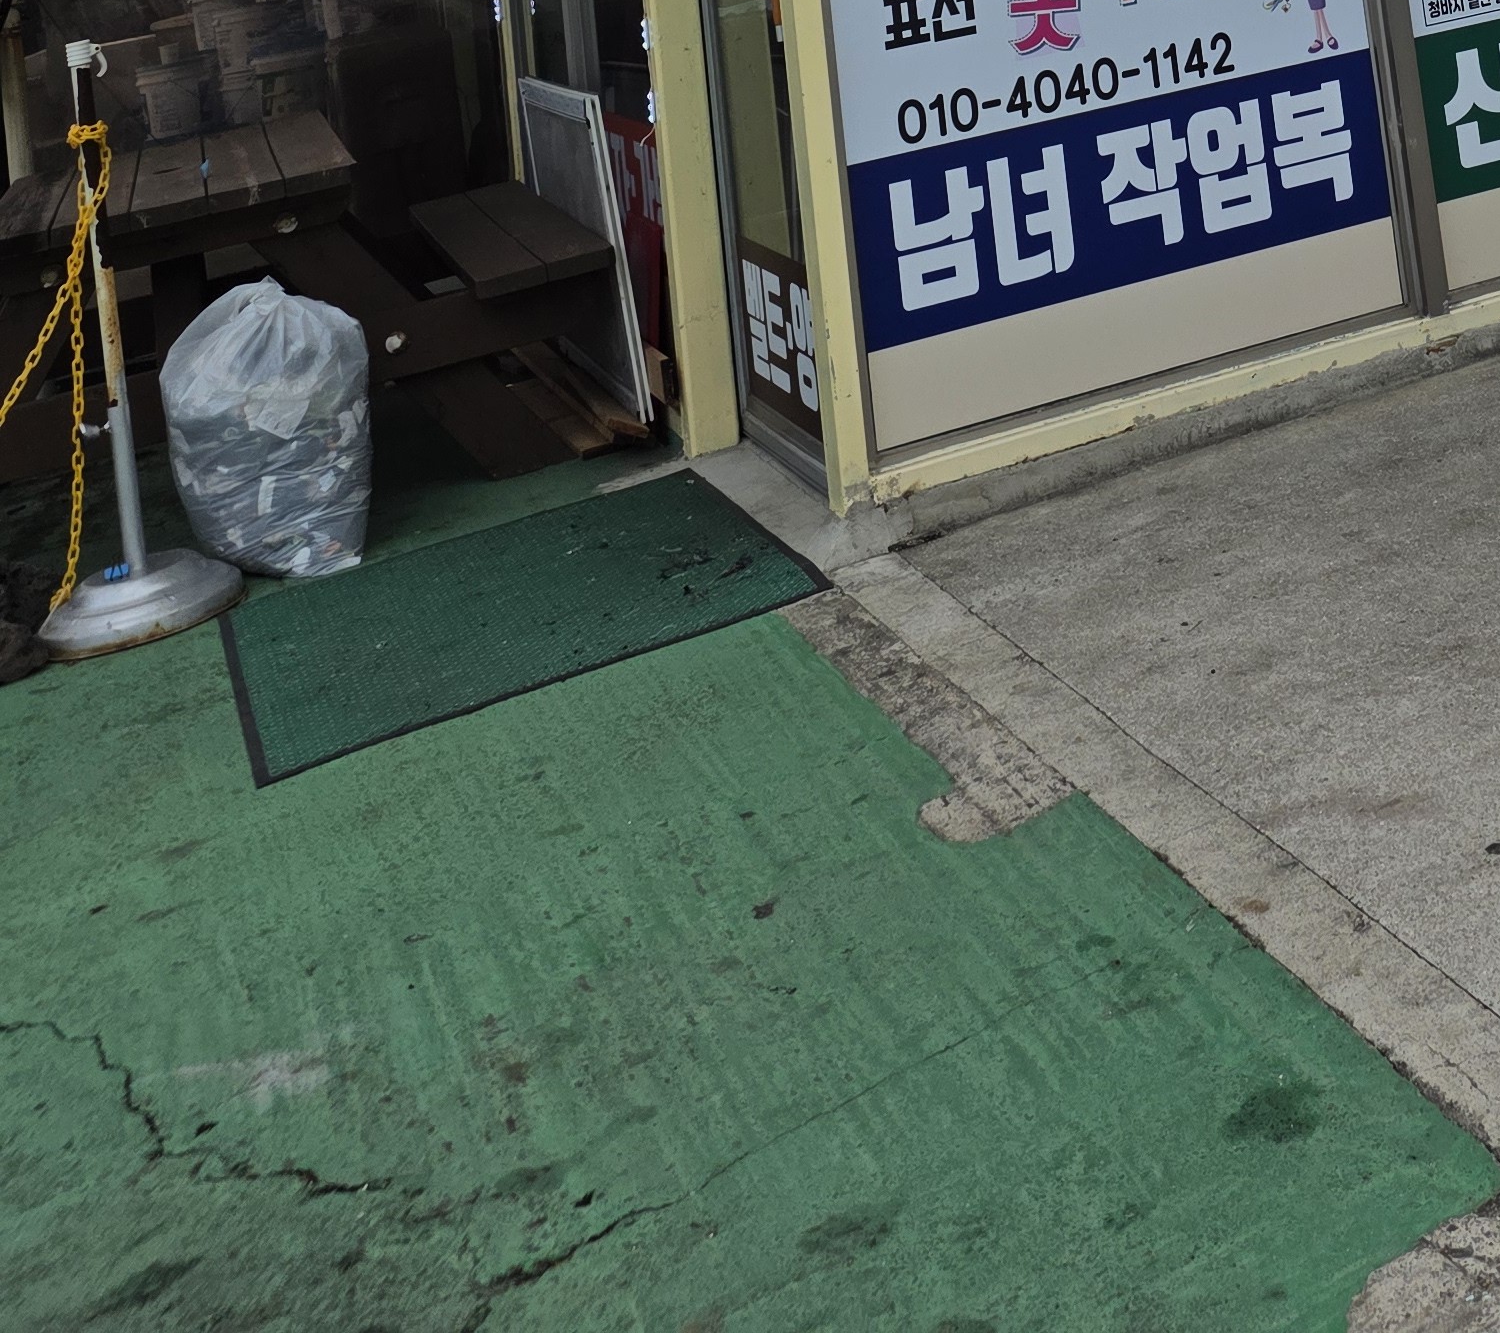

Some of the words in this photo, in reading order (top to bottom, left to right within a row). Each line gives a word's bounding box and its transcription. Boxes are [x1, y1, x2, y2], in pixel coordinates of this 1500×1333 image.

[897, 32, 1236, 144] 010-4040-1142
[888, 144, 1075, 312] 남녀
[1096, 79, 1354, 246] 작업복
